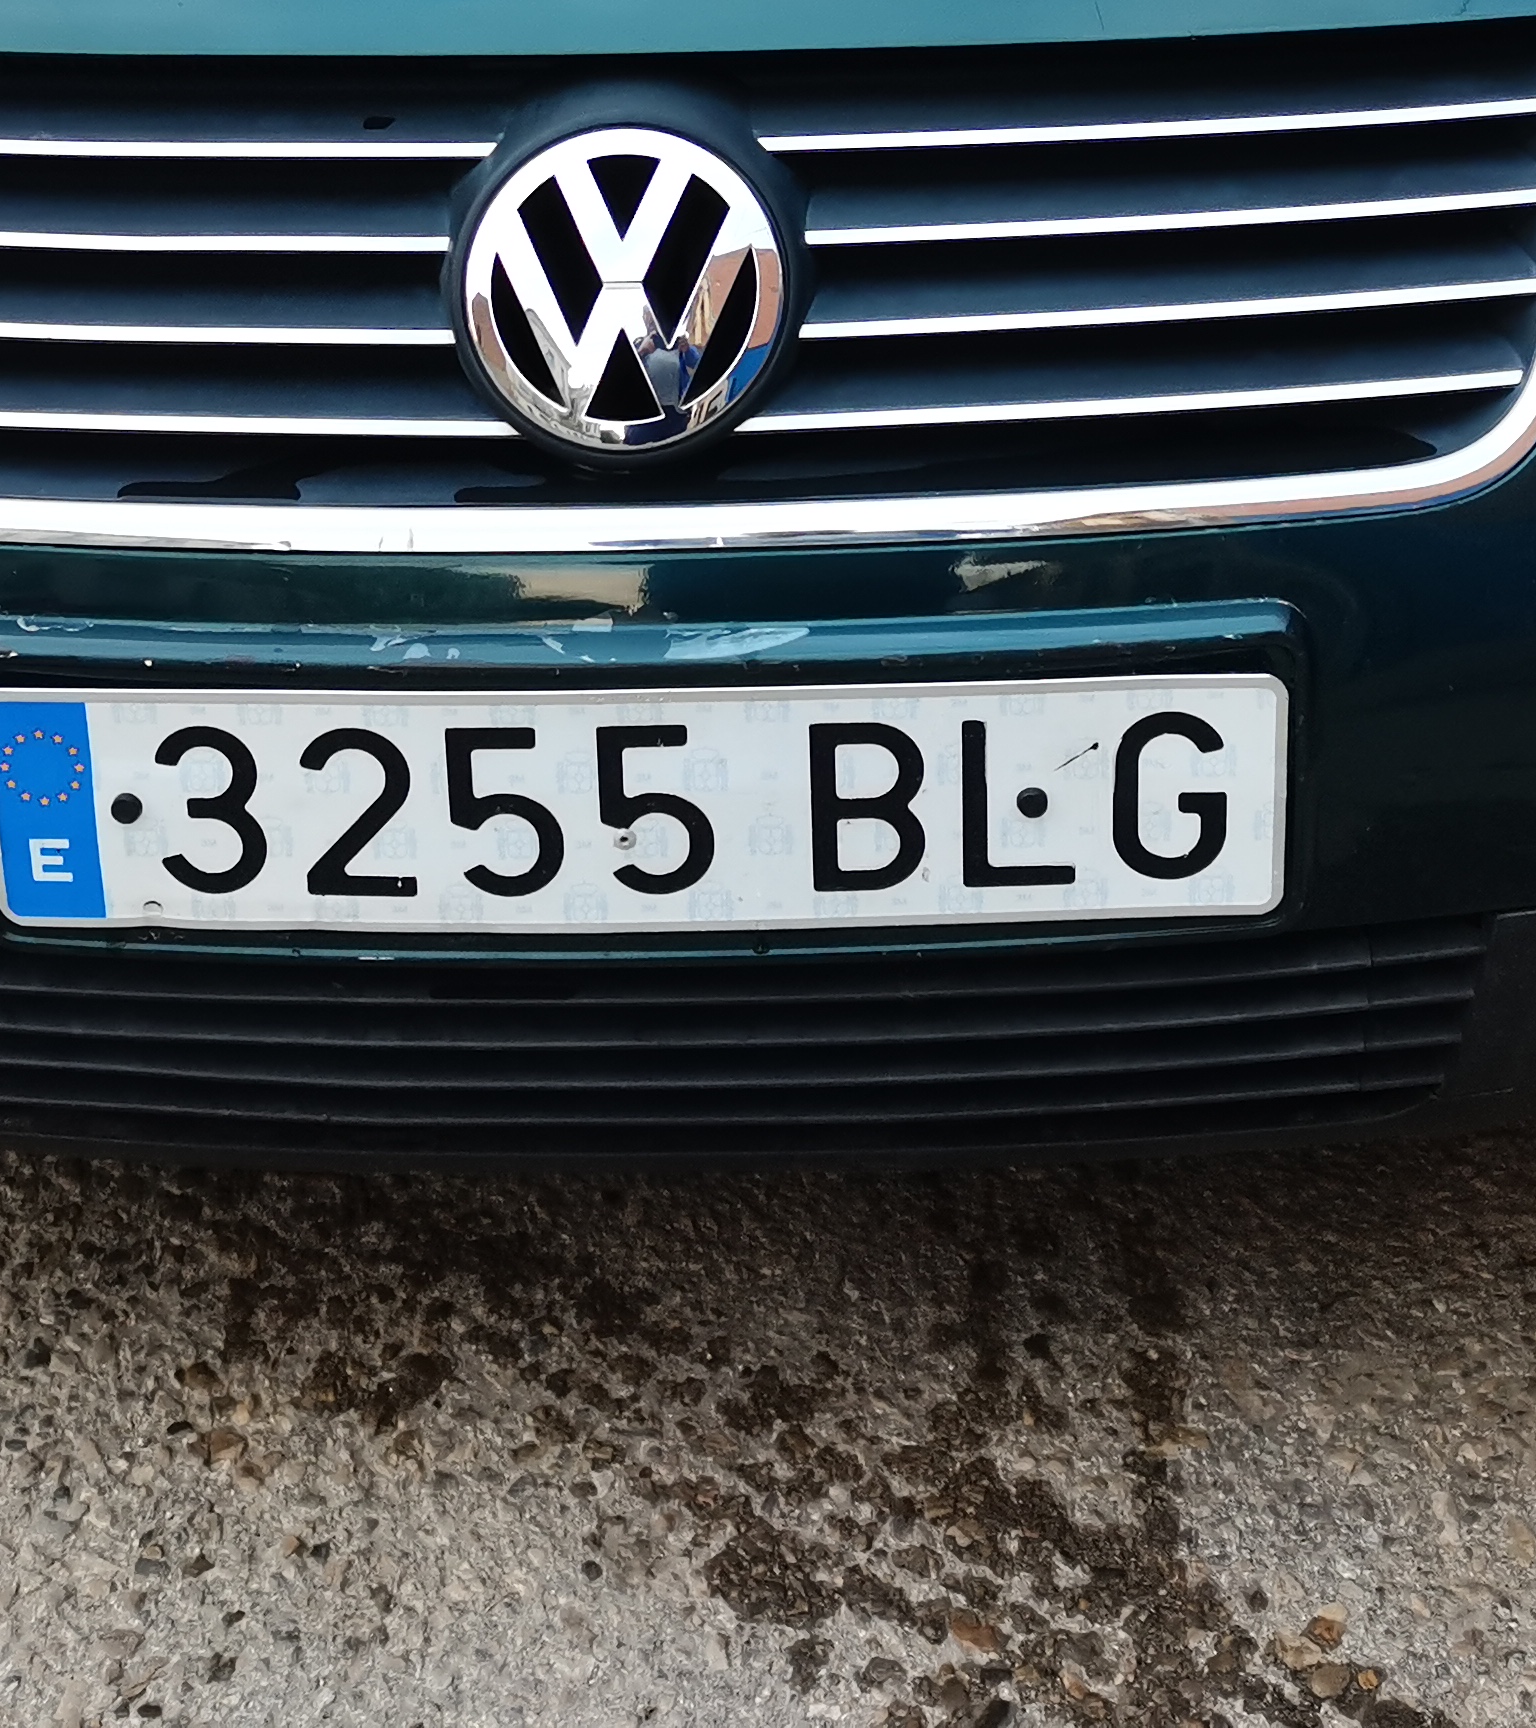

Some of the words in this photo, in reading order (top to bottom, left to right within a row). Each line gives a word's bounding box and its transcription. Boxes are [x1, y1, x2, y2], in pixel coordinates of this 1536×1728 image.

[30, 838, 74, 883] E
[154, 724, 716, 897] 3255
[808, 710, 1230, 894] BLG
